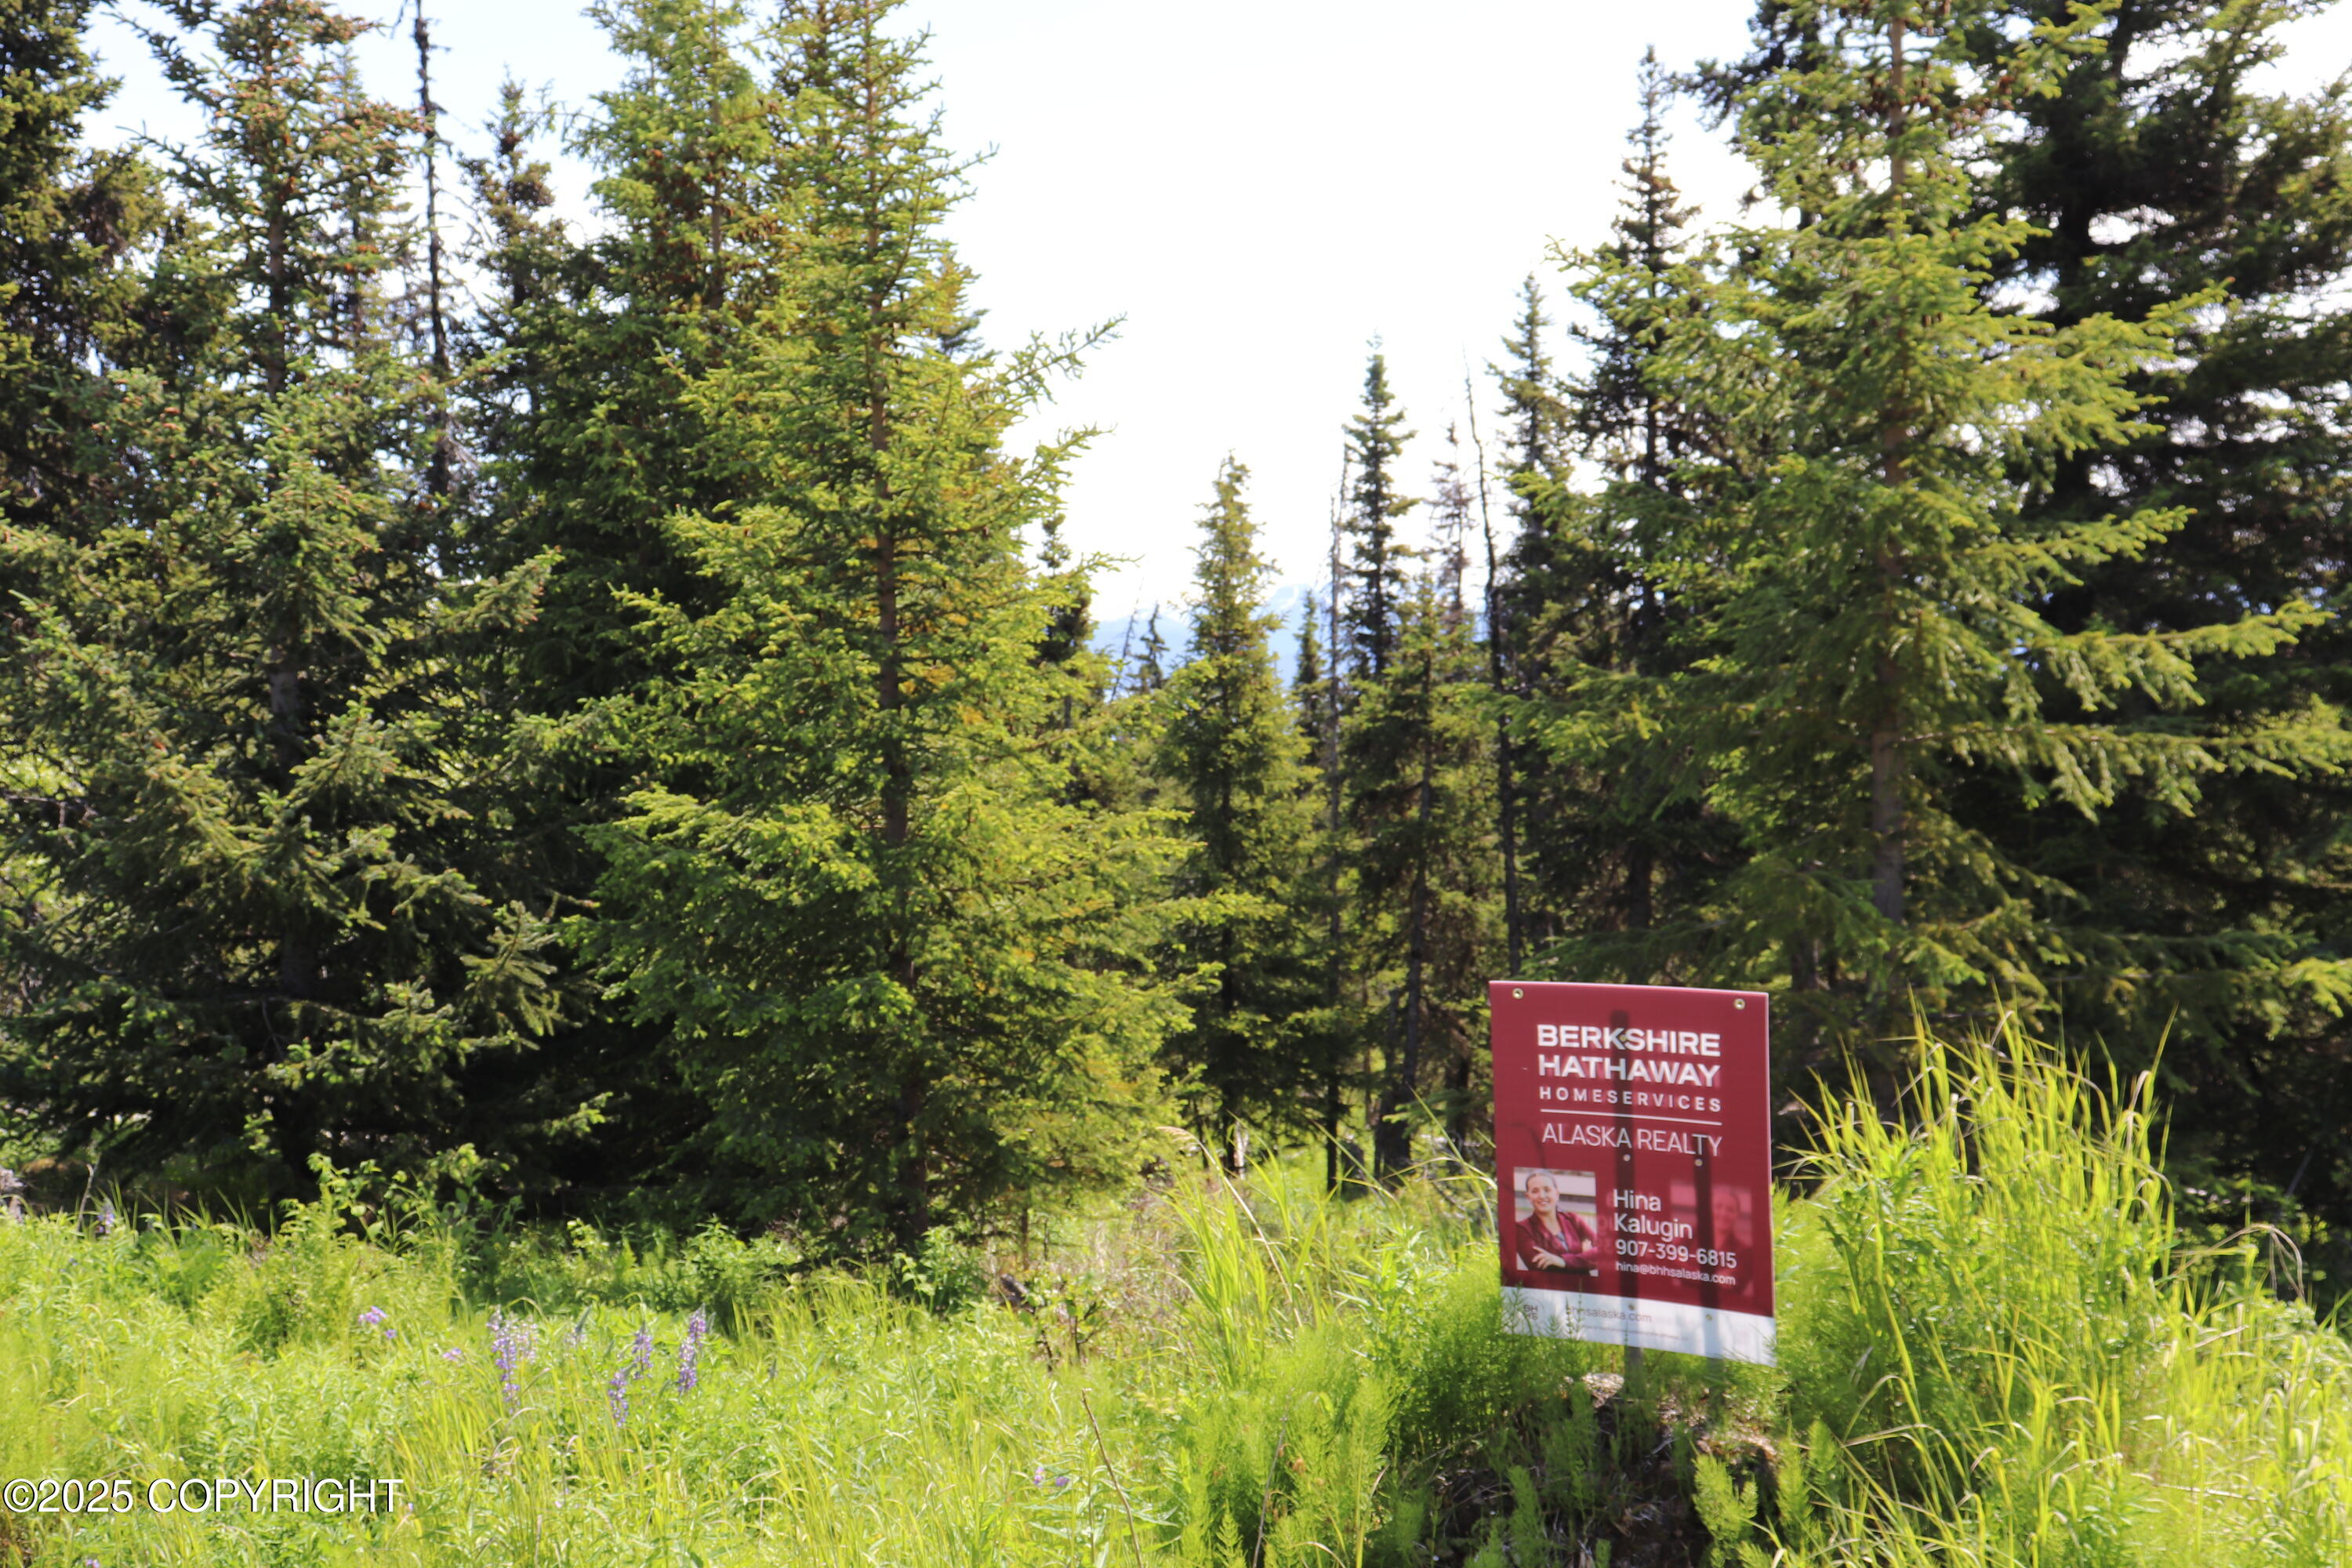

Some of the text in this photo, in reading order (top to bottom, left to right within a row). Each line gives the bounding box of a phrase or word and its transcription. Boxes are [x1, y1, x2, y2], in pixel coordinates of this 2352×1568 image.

[1537, 1025, 1721, 1057] BERKSHIRE
[1539, 1054, 1721, 1087] HATHAWAY
[1539, 1087, 1722, 1112] HOMESERVICES
[1542, 1123, 1722, 1156] ALASKA REALTY
[1613, 1189, 1661, 1211] Hina
[1613, 1213, 1693, 1242] Kalugin
[1615, 1239, 1737, 1269] 907-399-6815
[1615, 1261, 1736, 1286] hina@bhhsalaska.com
